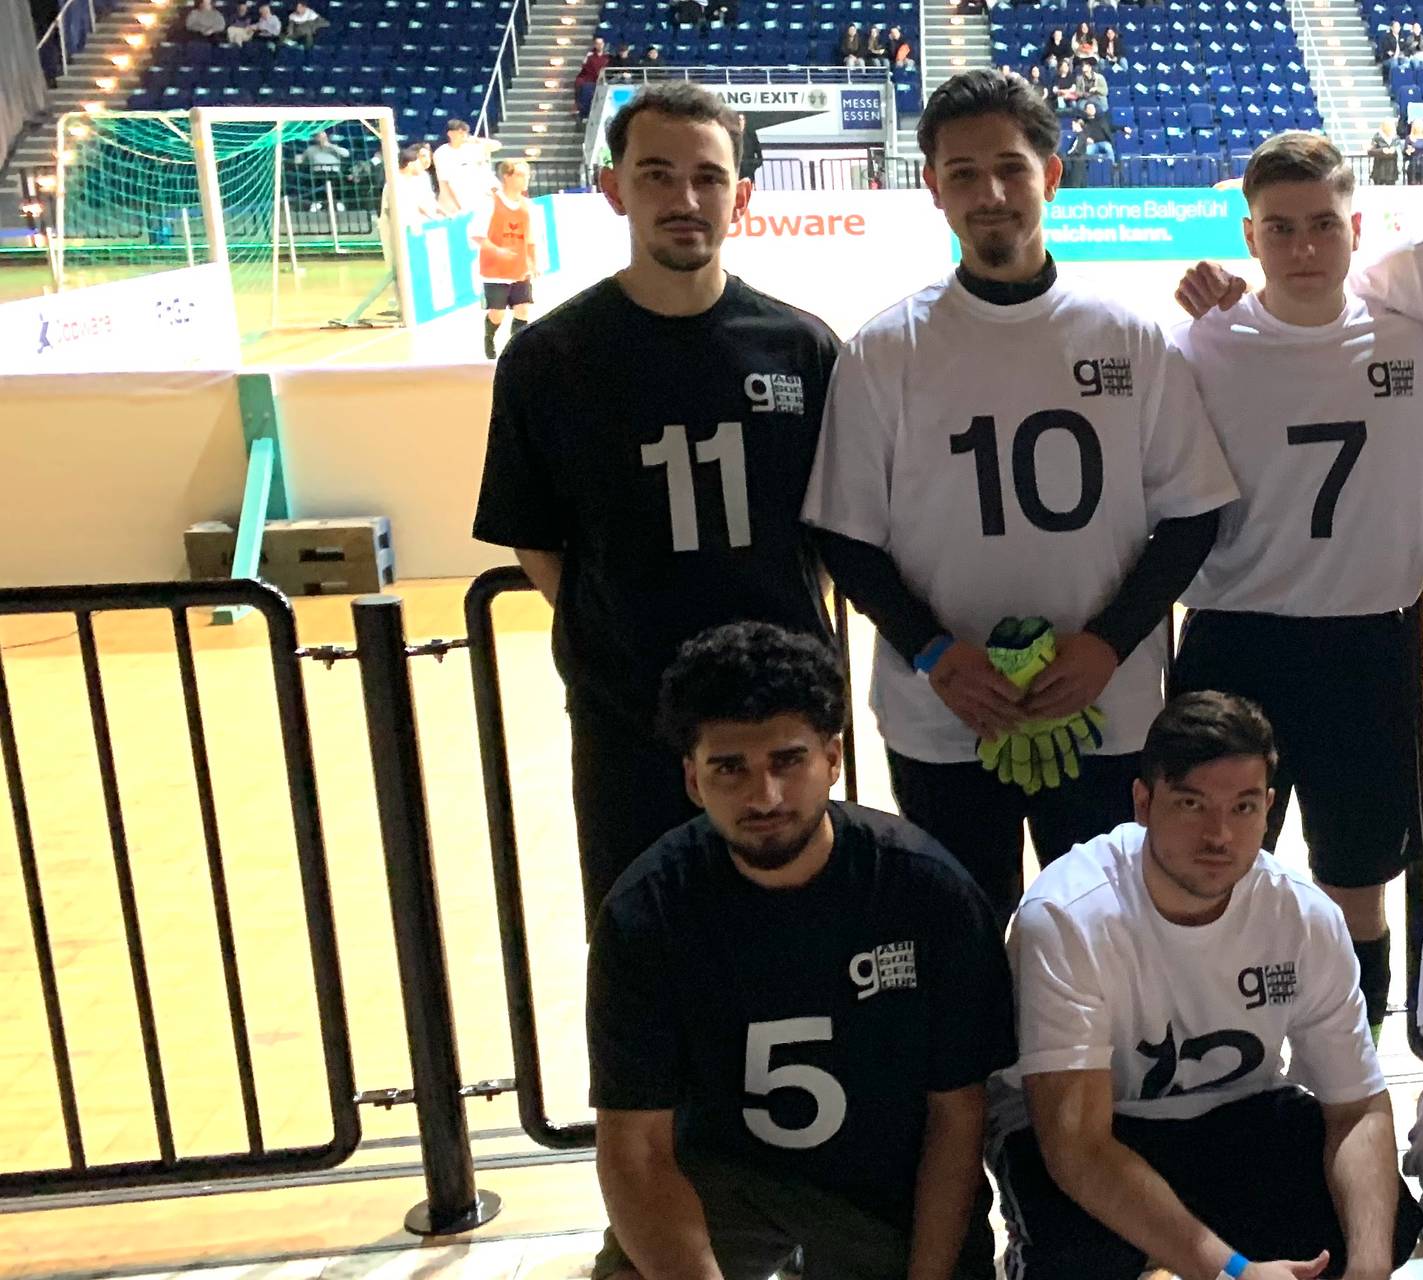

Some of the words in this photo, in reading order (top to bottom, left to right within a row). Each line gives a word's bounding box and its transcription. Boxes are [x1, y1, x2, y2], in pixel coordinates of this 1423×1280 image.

[843, 98, 880, 109] MESSE
[843, 111, 881, 121] ESSEN
[1051, 201, 1095, 219] auch
[1097, 201, 1141, 219] ohne
[1144, 200, 1228, 222] Ballgefühl
[640, 422, 752, 552] 11
[950, 408, 1104, 537] 10
[1286, 421, 1368, 539] 7
[742, 1016, 847, 1149] 5
[1135, 1019, 1265, 1101] 12
